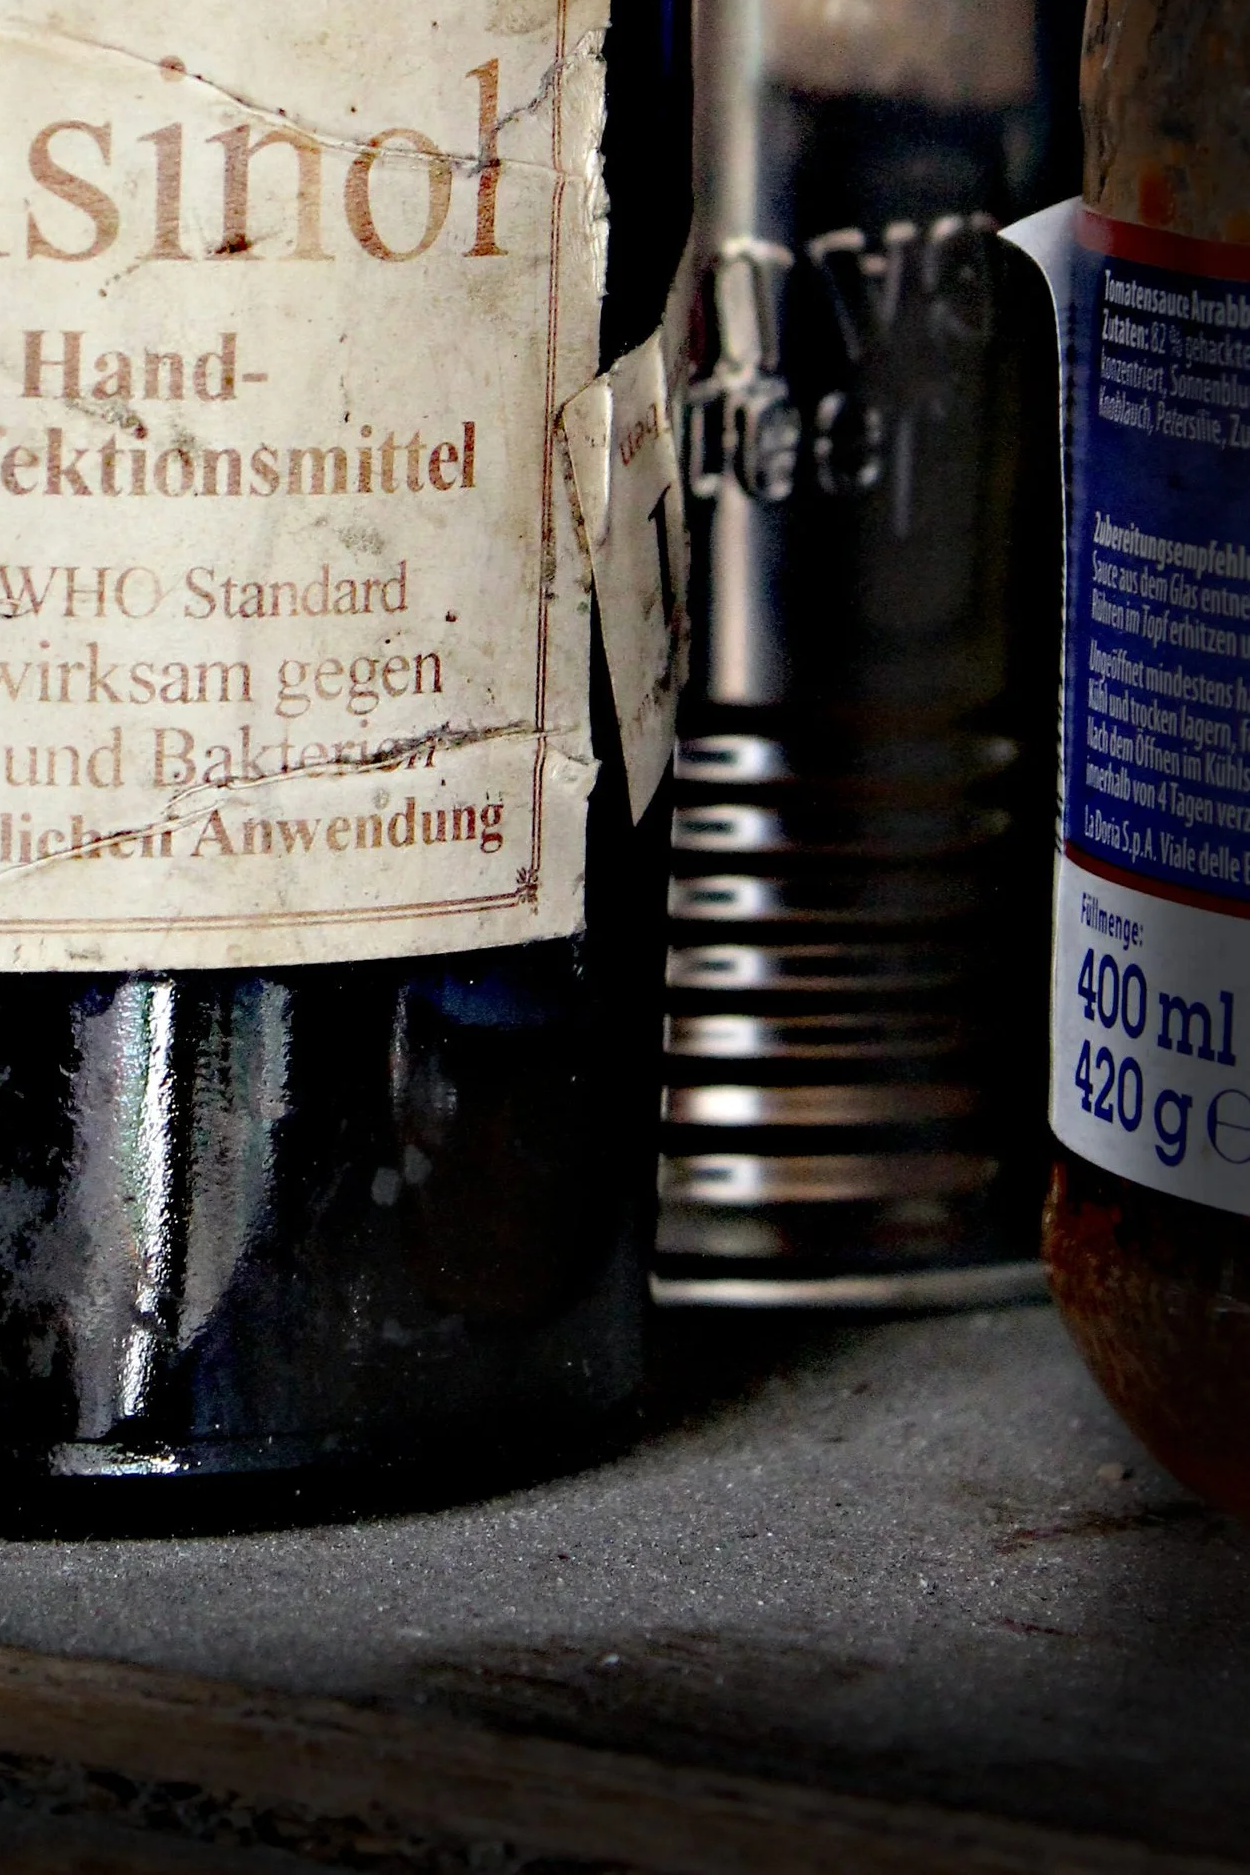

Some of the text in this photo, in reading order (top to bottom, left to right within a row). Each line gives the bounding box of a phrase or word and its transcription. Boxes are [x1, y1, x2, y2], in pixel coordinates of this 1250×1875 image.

[1105, 269, 1190, 319] Tomatensauce
[1102, 308, 1149, 351] Zutaten:
[20, 329, 268, 403] Hand-
[1093, 511, 1250, 580] Zubereitungsempfehl
[183, 559, 408, 619] Standard
[1092, 550, 1118, 588] Sauce
[1119, 566, 1138, 594] aus
[1140, 566, 1168, 601] dem
[1170, 573, 1198, 609] Glas
[1126, 601, 1140, 634] im
[1141, 604, 1170, 649] Topf
[1170, 614, 1236, 657] erhitzen
[275, 648, 445, 717] gegen
[1145, 662, 1233, 709] mindestens
[1088, 678, 1108, 715] Kühl
[1109, 690, 1129, 722] und
[1131, 699, 1177, 736] trocken
[1180, 705, 1237, 753] lagern,
[6, 723, 123, 789] und
[1087, 716, 1108, 755] Nach
[1110, 726, 1133, 762] dem
[1135, 727, 1180, 777] Öffnen
[1183, 747, 1201, 781] im
[1086, 755, 1131, 801] innerhalb
[1133, 779, 1155, 809] von
[1158, 781, 1167, 812] 4
[1169, 782, 1213, 828] Tagen
[190, 797, 506, 860] Anwendung
[1095, 809, 1120, 850] Doria
[1122, 820, 1157, 863] S.p.A.
[1160, 831, 1195, 872] Viale
[1200, 842, 1240, 882] delle
[1081, 892, 1144, 951] Füllmenge:
[1077, 947, 1237, 1067] 400 ml
[1075, 1039, 1193, 1167] 420 g
